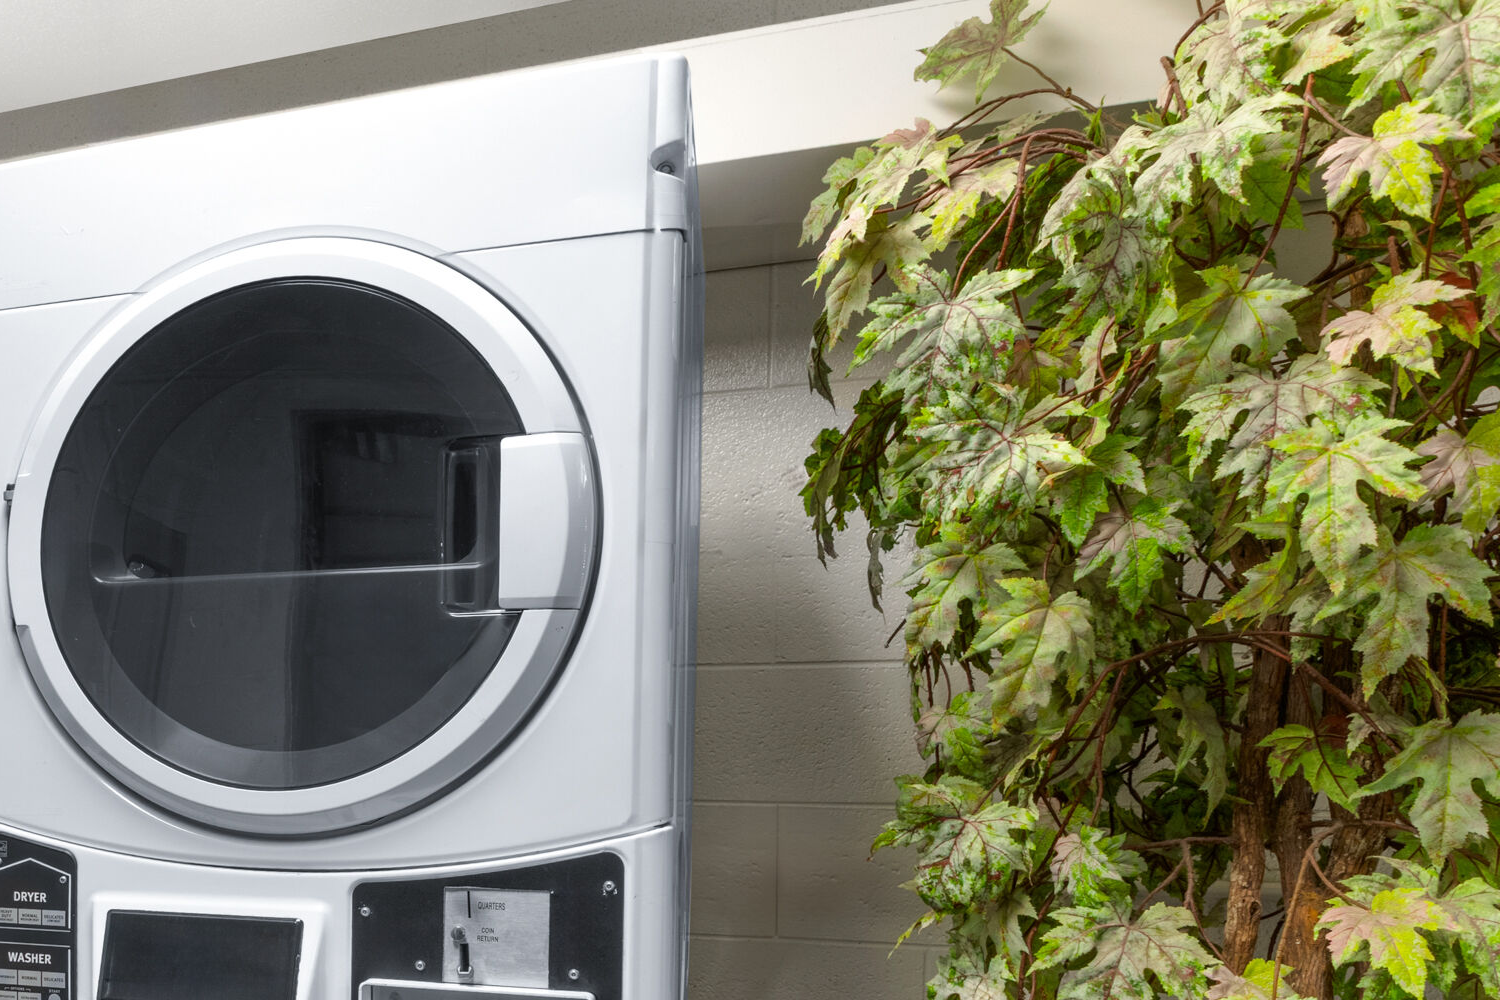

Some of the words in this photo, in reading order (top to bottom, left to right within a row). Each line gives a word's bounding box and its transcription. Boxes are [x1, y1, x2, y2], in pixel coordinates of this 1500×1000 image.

[13, 891, 47, 903] DRYER
[478, 901, 506, 911] QUARTERS
[8, 951, 52, 965] WASHER
